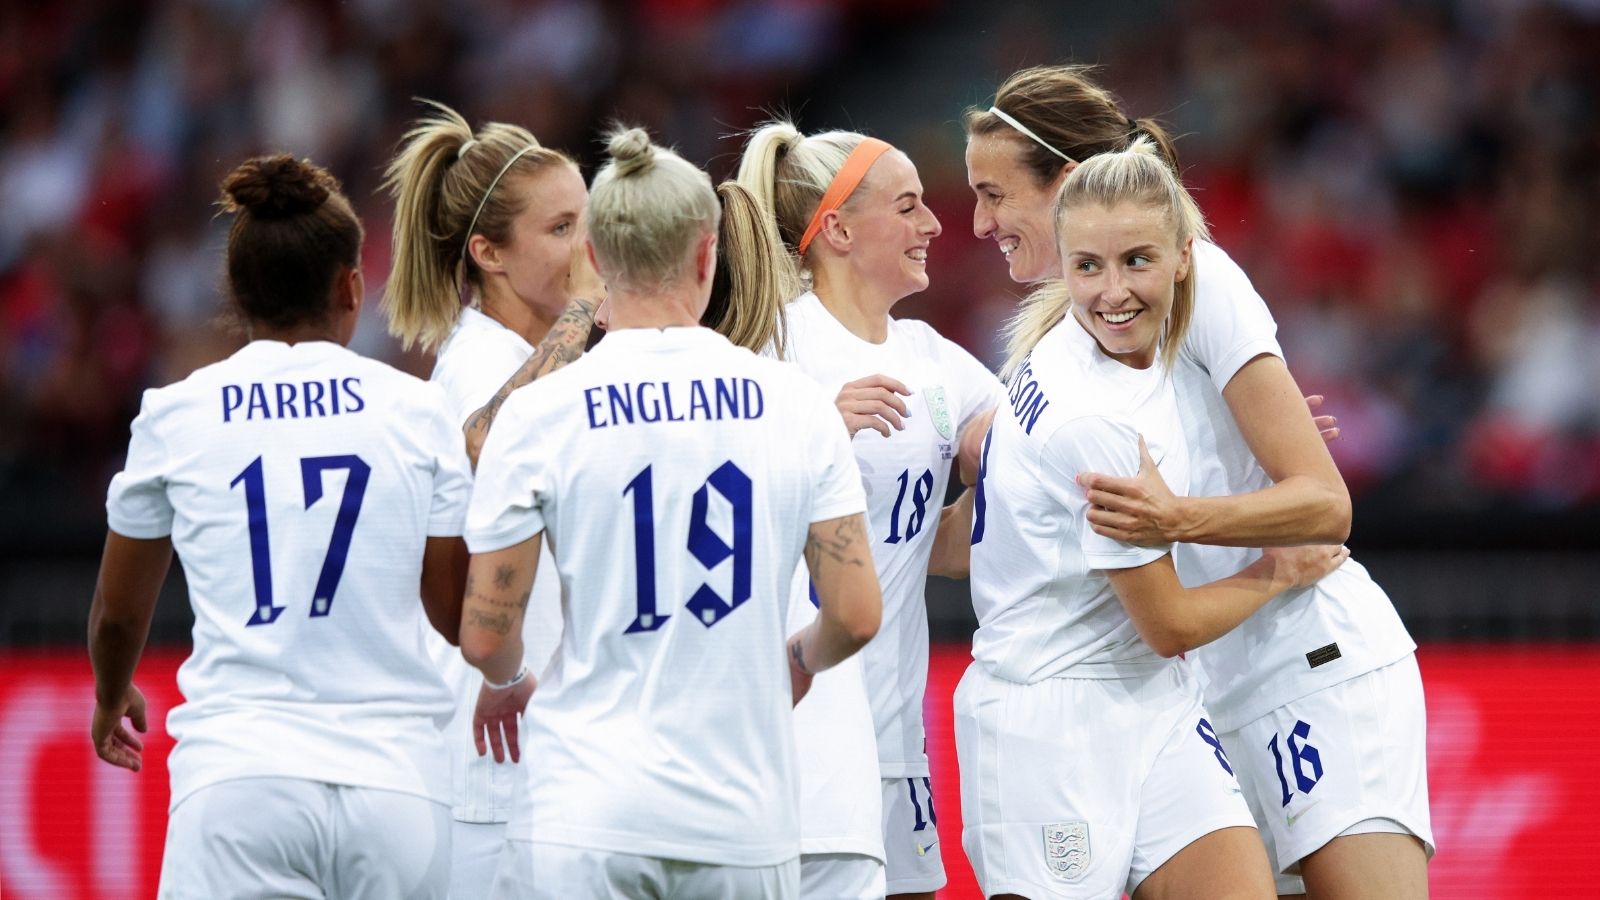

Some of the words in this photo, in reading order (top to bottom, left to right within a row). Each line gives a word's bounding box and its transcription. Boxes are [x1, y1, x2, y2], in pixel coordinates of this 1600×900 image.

[222, 377, 365, 423] PARRIS
[584, 377, 764, 429] ENGLAND
[230, 454, 372, 627] 17
[623, 459, 753, 634] 19
[884, 468, 934, 545] 18
[1267, 720, 1324, 808] 16
